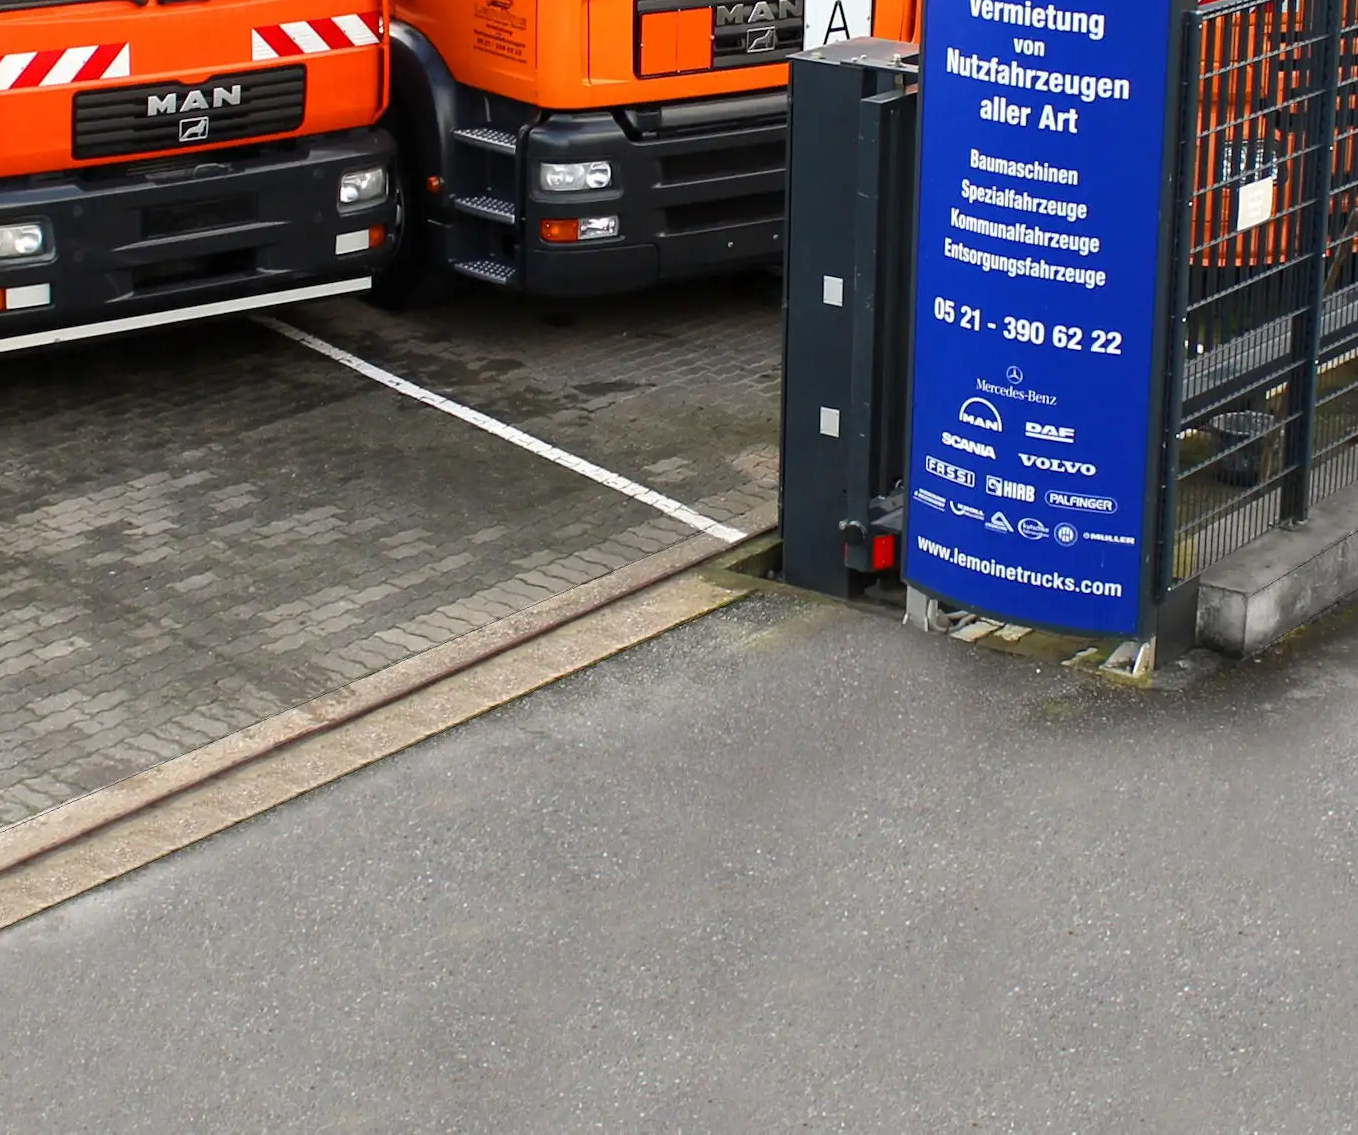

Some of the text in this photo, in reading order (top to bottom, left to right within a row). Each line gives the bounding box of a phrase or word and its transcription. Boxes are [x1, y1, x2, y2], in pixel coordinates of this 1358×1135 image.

[1014, 38, 1044, 56] von
[947, 48, 1129, 99] Nutzfahrzeugen
[148, 85, 242, 117] MAN
[980, 98, 1078, 133] aller Art
[971, 149, 1078, 185] Baumaschinen
[962, 179, 1087, 221] Spezialfahrzeuge
[951, 208, 1099, 255] Kommunalfahrzeuge
[945, 238, 1105, 288] Entsorgungsfahrzeuge
[935, 297, 1122, 354] 05 21 - 390 62 22
[976, 378, 1057, 405] Mercedes-Benz
[963, 413, 998, 430] MAN
[1026, 422, 1074, 437] DAF
[942, 432, 995, 459] SCANIA
[929, 460, 973, 484] FASSI
[1019, 453, 1096, 475] VOLVO
[1003, 481, 1035, 502] HIAB
[1049, 493, 1113, 511] PALFINGER
[918, 536, 1121, 597] www.lemoinetrucks.com
